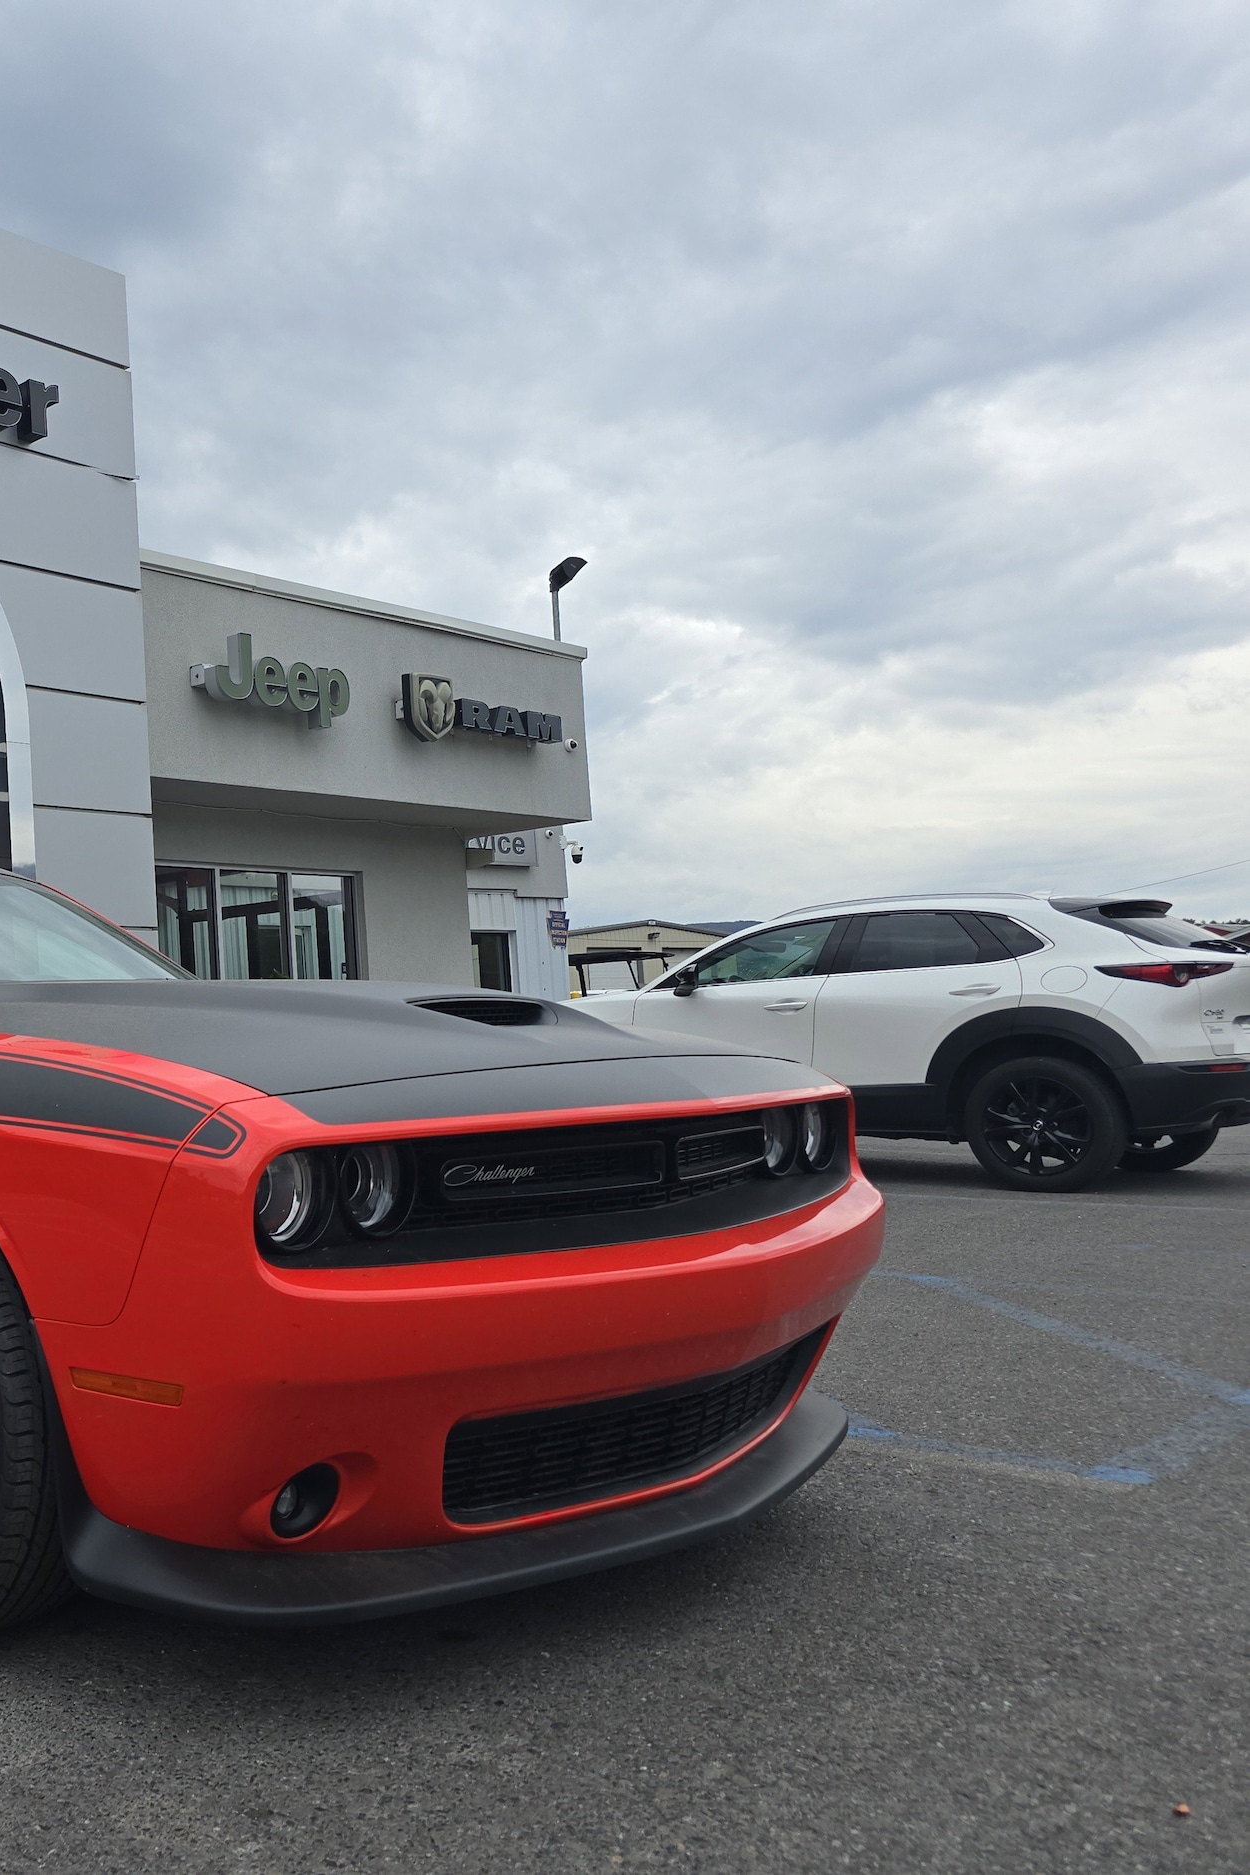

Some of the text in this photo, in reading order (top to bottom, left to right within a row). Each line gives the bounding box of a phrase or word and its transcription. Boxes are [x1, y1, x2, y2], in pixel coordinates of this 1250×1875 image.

[204, 632, 350, 729] Jeep
[454, 698, 562, 743] RAM
[443, 1164, 535, 1187] Challenger
